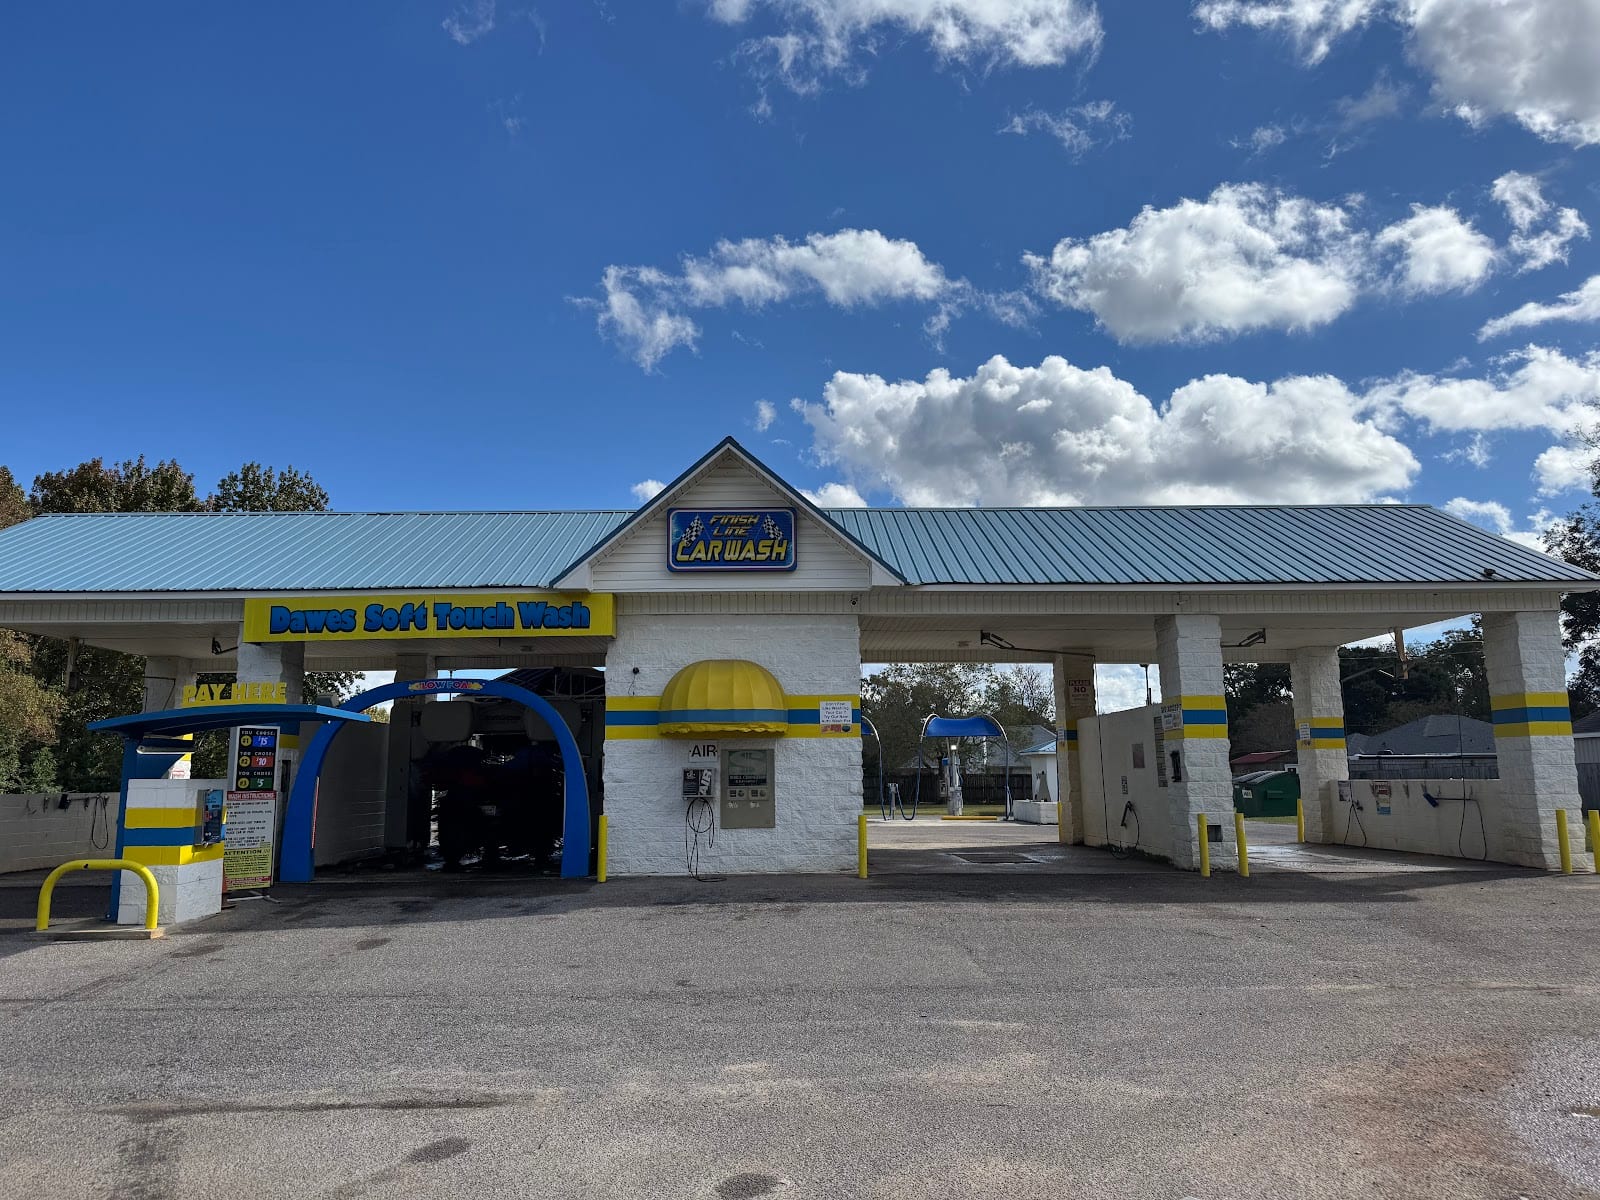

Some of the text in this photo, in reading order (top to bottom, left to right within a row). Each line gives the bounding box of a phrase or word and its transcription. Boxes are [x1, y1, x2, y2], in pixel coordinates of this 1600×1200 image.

[709, 515, 760, 525] FINISH
[712, 526, 752, 536] LINE
[269, 600, 590, 634] Dawes Soft Touch Wash
[183, 682, 287, 703] PAY HERE
[691, 744, 716, 757] AIR
